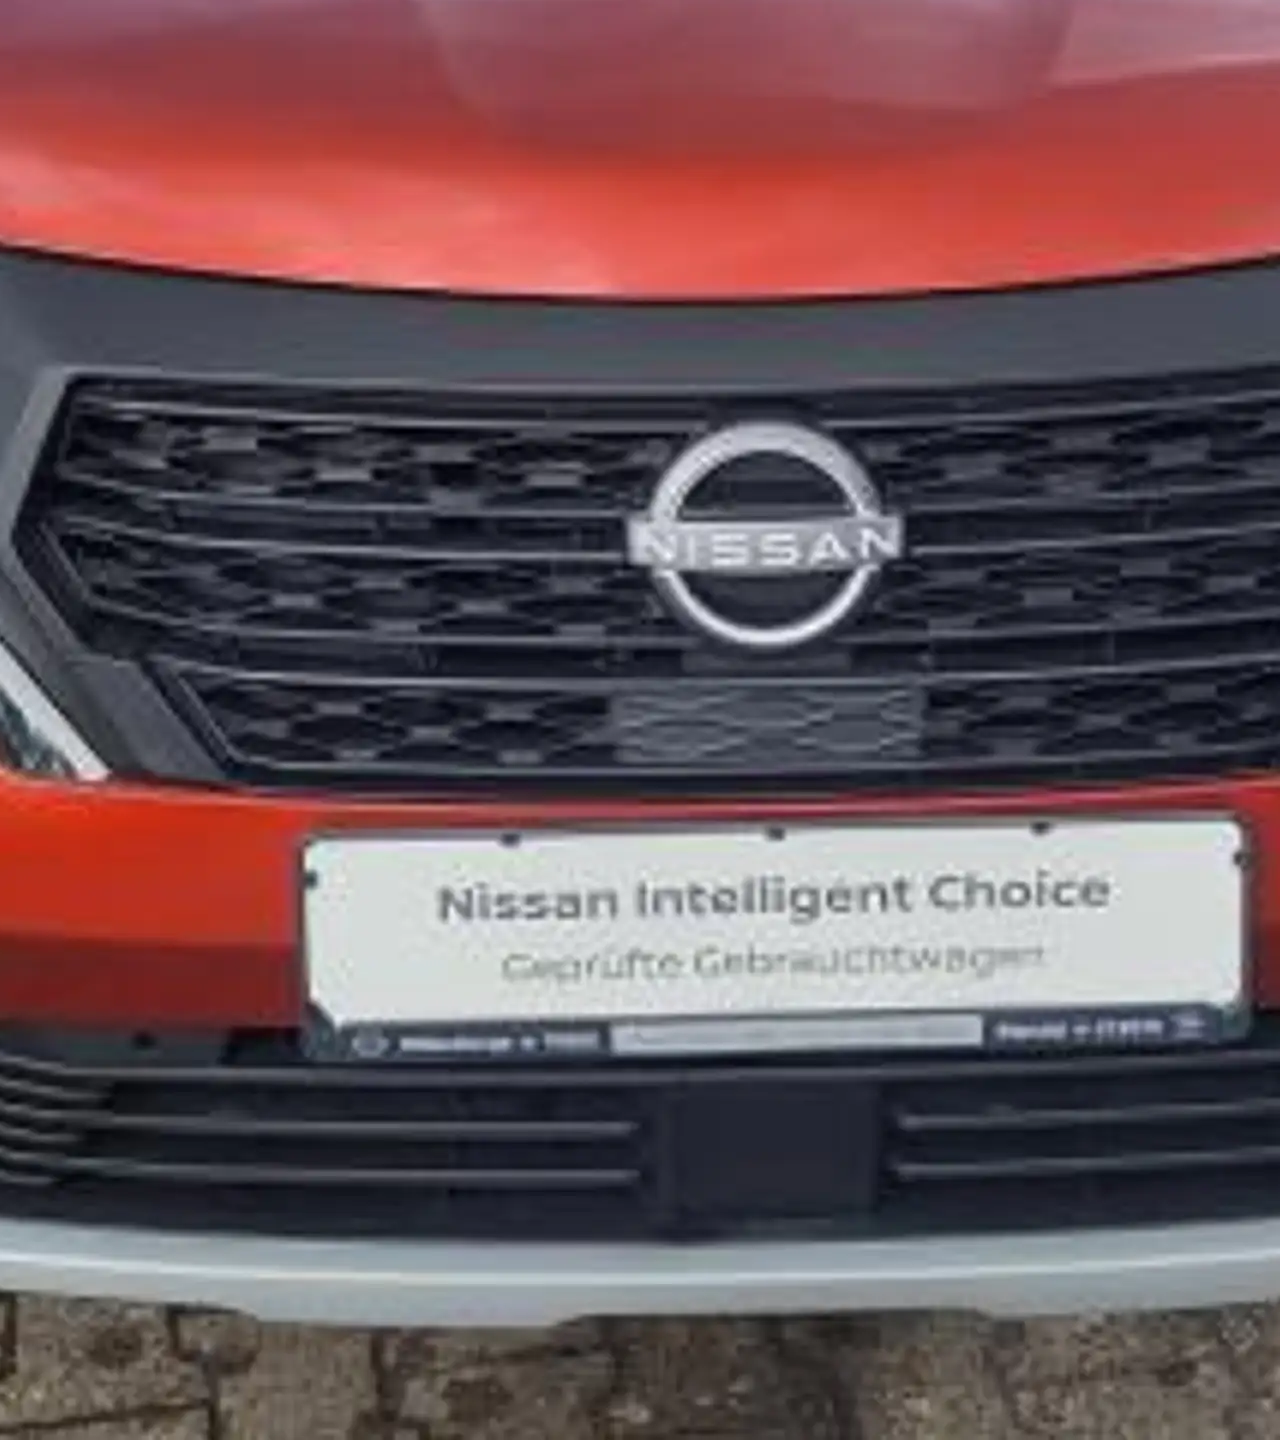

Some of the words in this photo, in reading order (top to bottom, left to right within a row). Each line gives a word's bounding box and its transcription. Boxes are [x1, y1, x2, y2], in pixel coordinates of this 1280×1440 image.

[631, 522, 901, 568] NISSAN
[437, 883, 618, 922] Nissan
[637, 875, 914, 925] Intelligent
[927, 869, 1111, 911] Choice
[502, 946, 684, 984] Geprüfte
[693, 943, 1046, 979] Gebrauchtwagen
